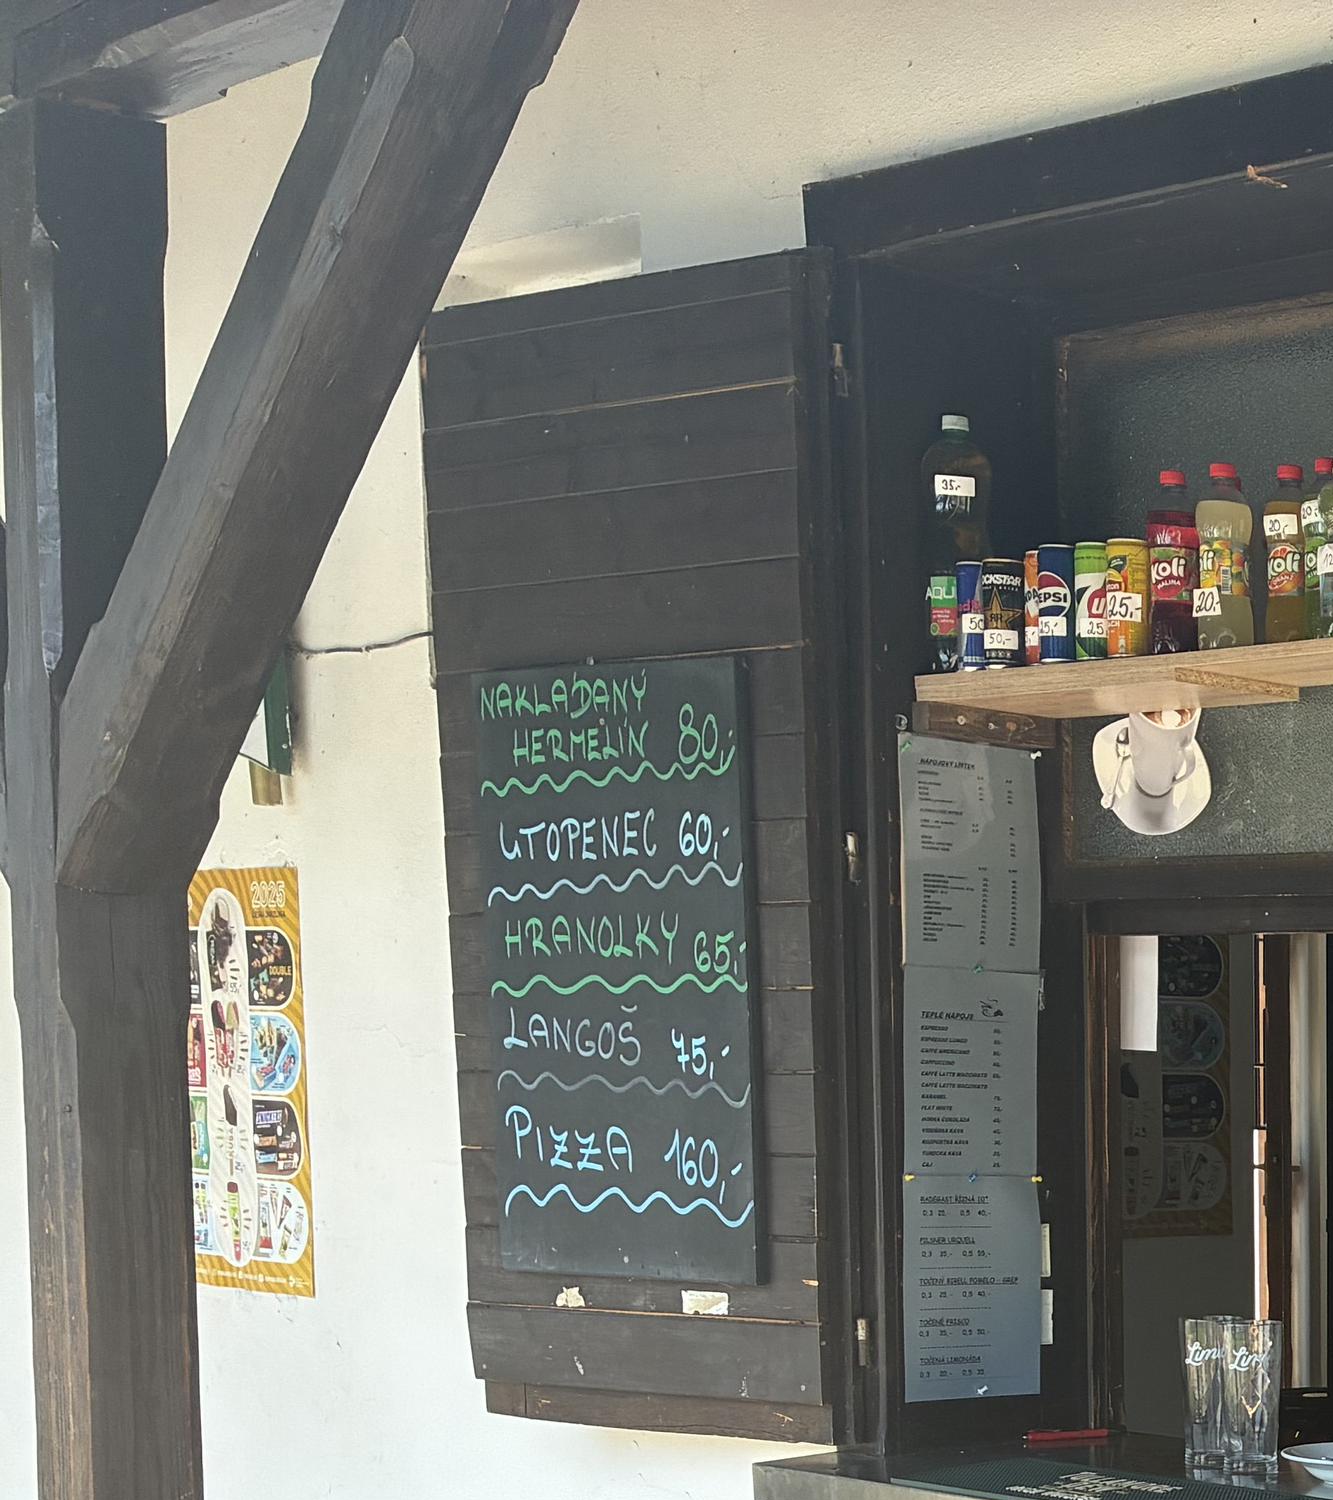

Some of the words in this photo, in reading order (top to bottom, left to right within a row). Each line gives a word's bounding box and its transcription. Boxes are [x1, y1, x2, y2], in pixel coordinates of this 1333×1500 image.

[1108, 594, 1142, 619] 25,-
[499, 808, 658, 860] UTOPENEC
[678, 814, 731, 860] 60,-
[251, 880, 286, 909] 2025
[504, 913, 679, 964] HRANOLKY
[503, 1004, 642, 1067] LANGOŠ
[504, 1105, 633, 1172] PIZZA
[664, 1129, 743, 1205] 160,-
